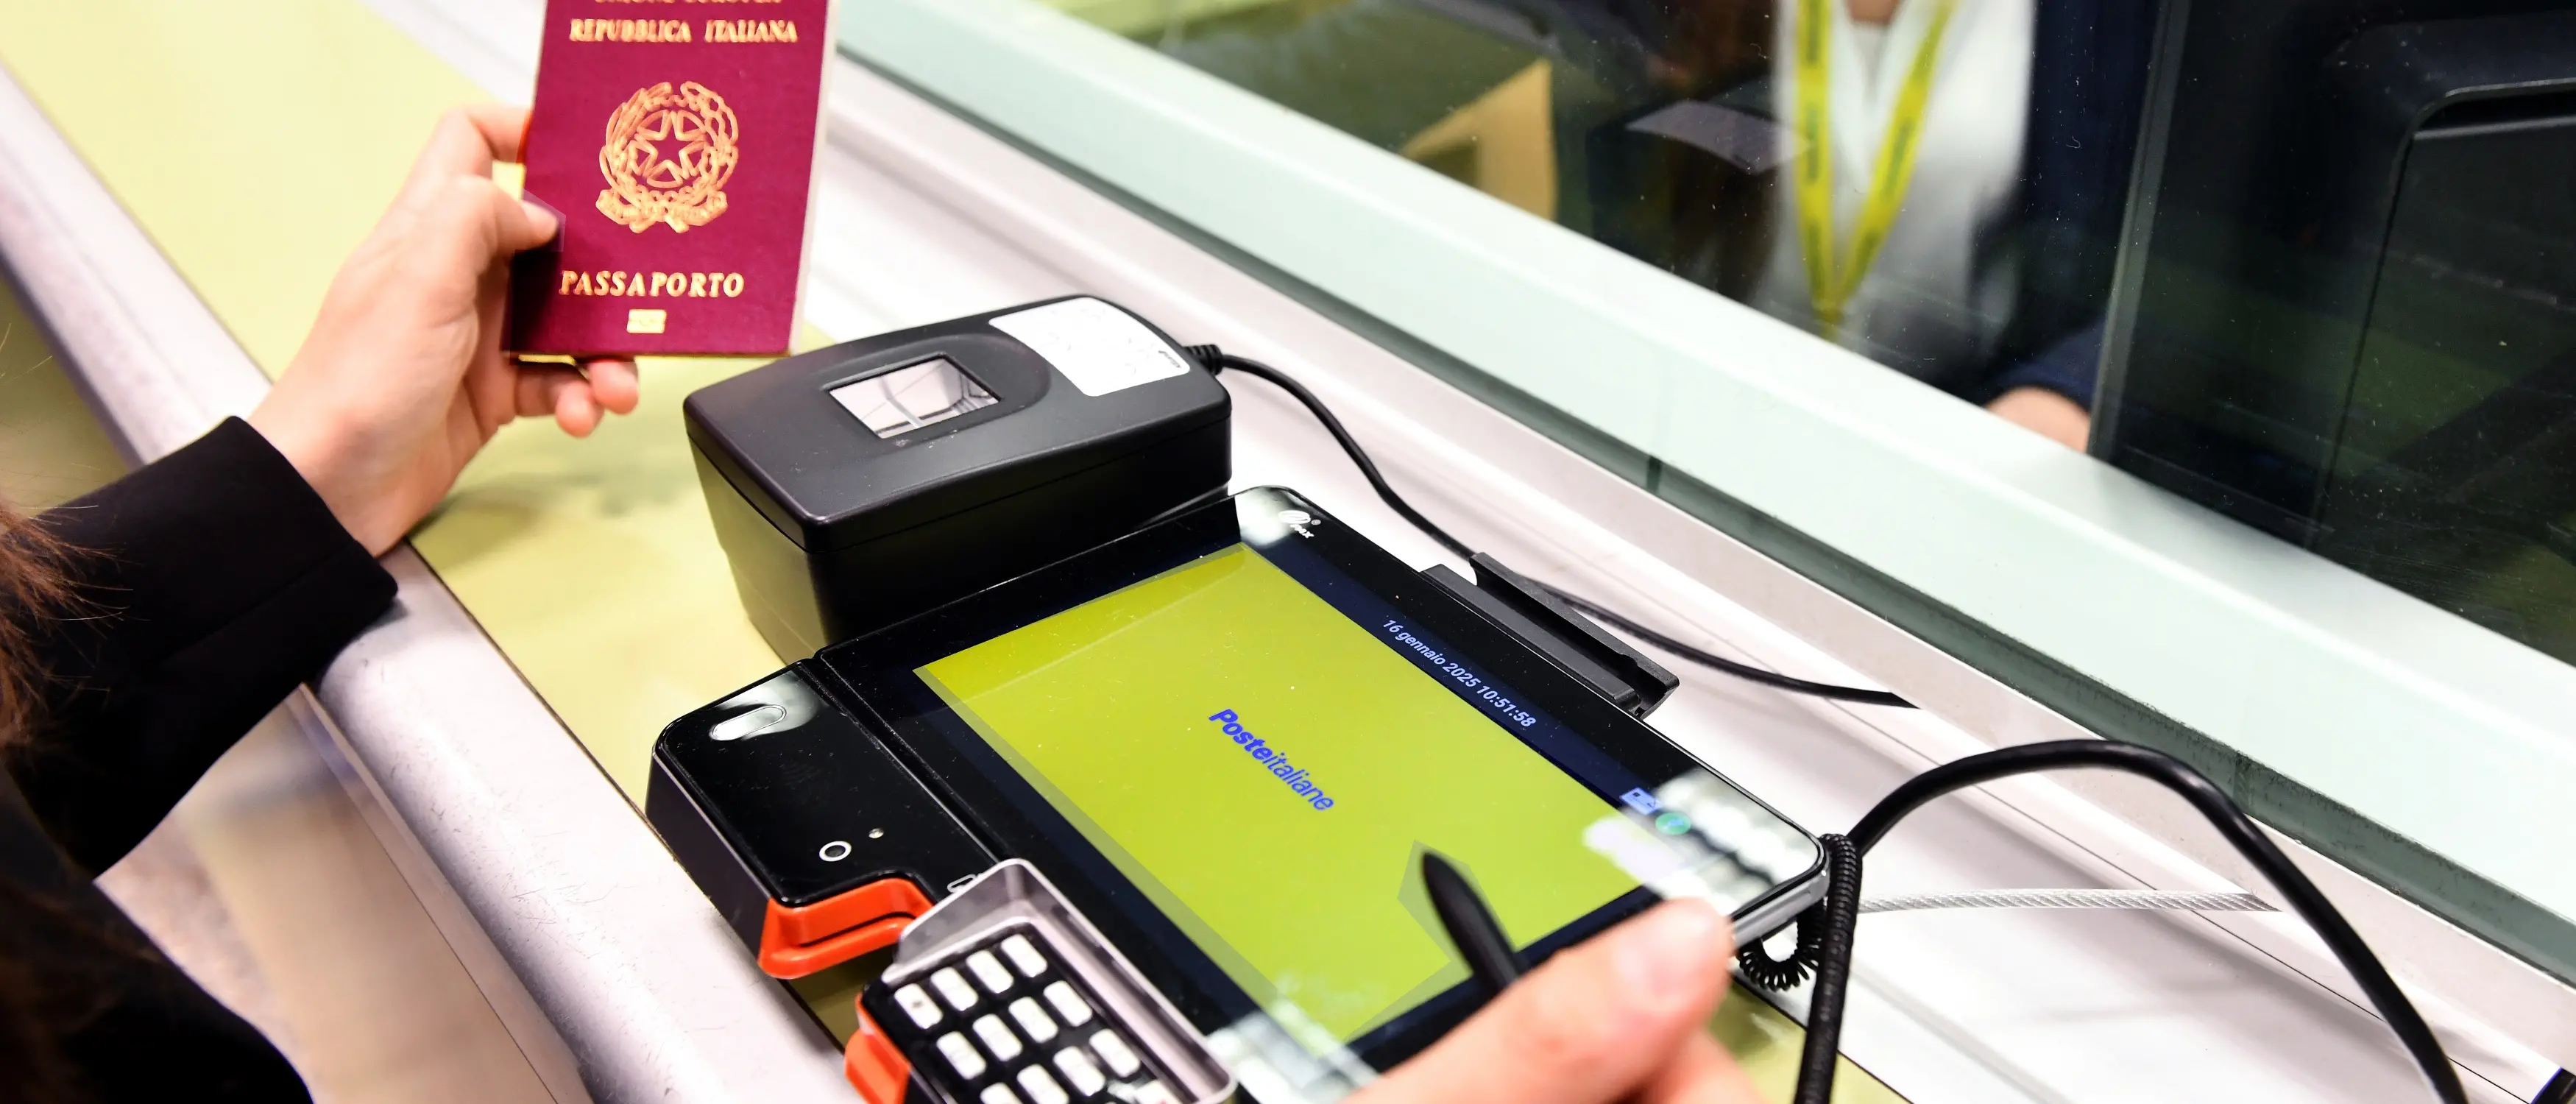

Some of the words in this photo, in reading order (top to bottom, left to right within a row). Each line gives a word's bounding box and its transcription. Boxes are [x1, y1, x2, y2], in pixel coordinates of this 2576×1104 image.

[569, 18, 693, 43] REPUBBLICA
[704, 19, 799, 43] ITALIANA
[559, 270, 745, 297] PASSAPORTO
[1383, 620, 1404, 633] 16
[1395, 631, 1446, 665] gennaio
[1442, 662, 1482, 687] 2025
[1476, 685, 1537, 727] 10:51:58
